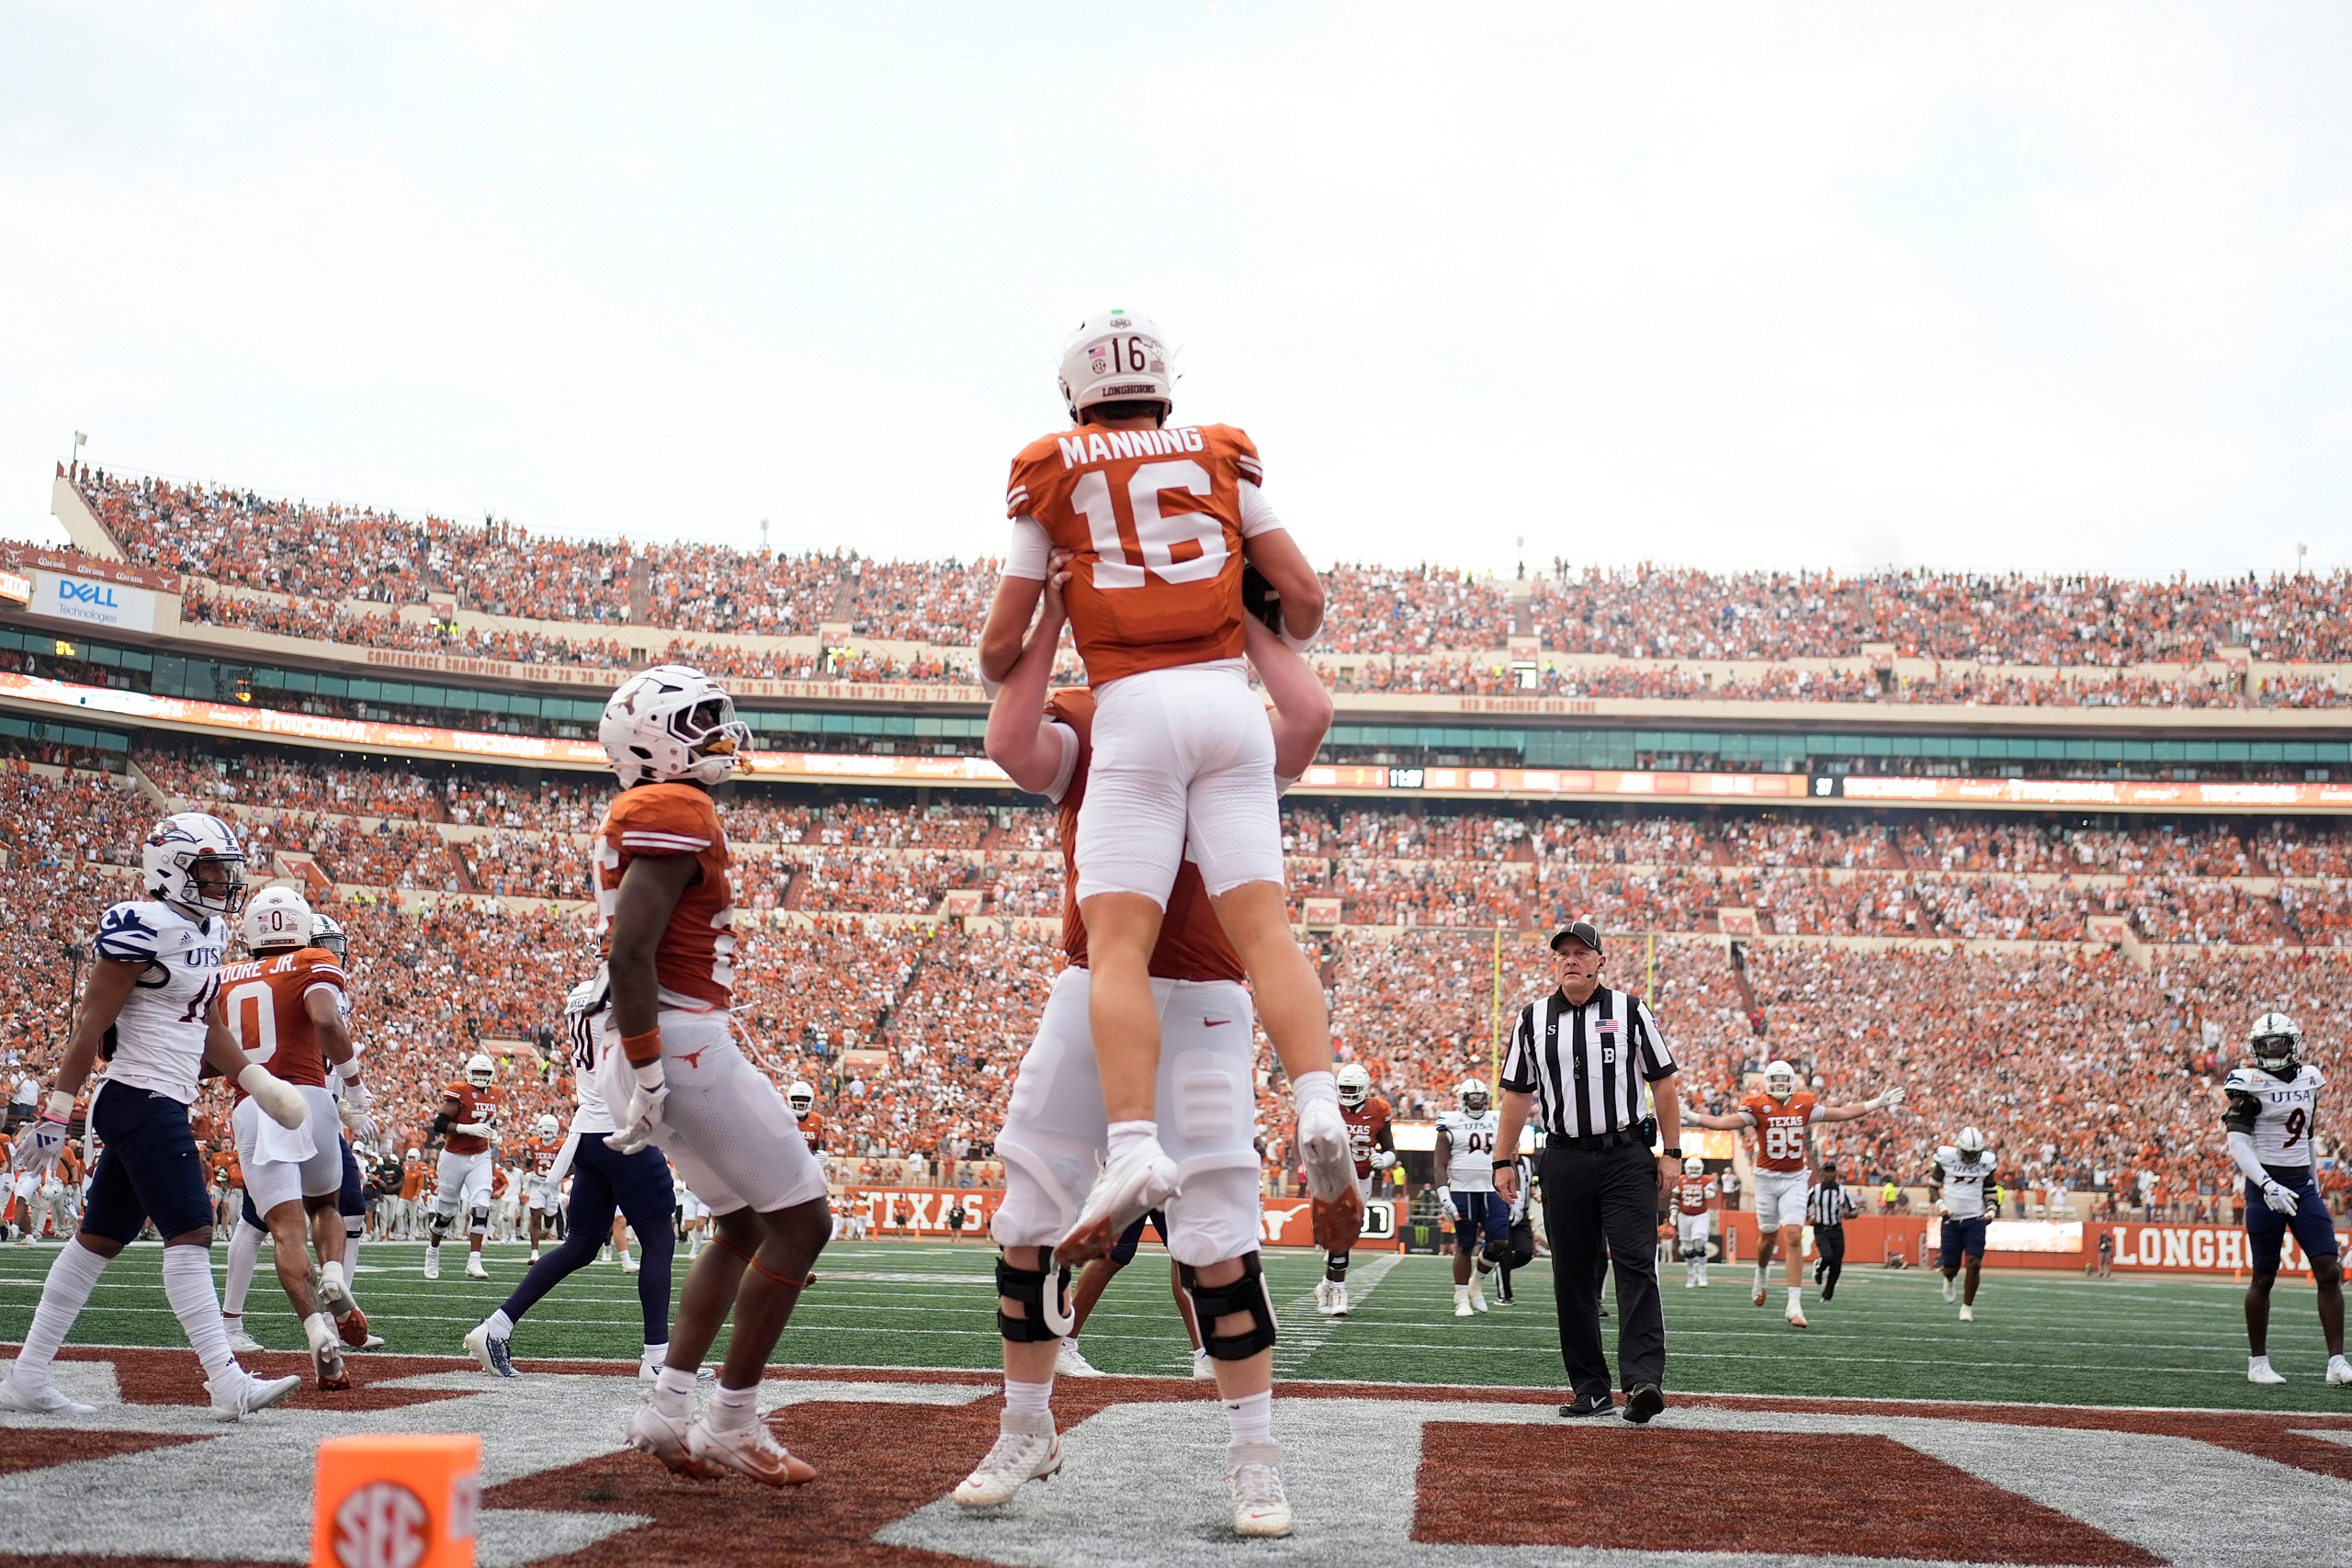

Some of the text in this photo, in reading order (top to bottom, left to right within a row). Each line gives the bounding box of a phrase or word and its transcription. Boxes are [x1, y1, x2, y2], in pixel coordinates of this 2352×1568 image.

[1112, 336, 1146, 374] 16
[1102, 384, 1156, 398] LONGHORNS
[1057, 428, 1204, 469] MANNING
[1070, 459, 1231, 589] 16
[38, 557, 66, 570] Corona
[77, 564, 105, 578] Corona
[116, 571, 143, 584] Corona
[59, 580, 118, 608] DELL
[59, 604, 118, 624] Technologies
[368, 650, 439, 670] CONFERENCE
[446, 657, 512, 676] CHAMPIONS
[274, 713, 367, 740] TOUCHDOWN
[452, 732, 546, 757] TOUCHDOWN
[272, 910, 282, 931] 0
[260, 939, 297, 947] LONGHORNS
[185, 947, 221, 968] UTS
[220, 953, 297, 985] OORE JR.
[226, 980, 278, 1065] 0
[1547, 1024, 1557, 1036] S
[1604, 1047, 1615, 1064] B
[2271, 1089, 2311, 1103] UTSA
[475, 1102, 497, 1112] TEXAS
[1465, 1122, 1494, 1131] UTSA
[1767, 1115, 1804, 1127] TEXAS
[2283, 1108, 2305, 1148] 9
[800, 1131, 816, 1140] XAS
[1468, 1133, 1494, 1155] 95
[1766, 1127, 1804, 1160] 85
[535, 1152, 558, 1161] TEXAS
[866, 1191, 983, 1232] TEXAS
[2113, 1226, 2349, 1271] LONGHR
[334, 1482, 427, 1568] SEC
